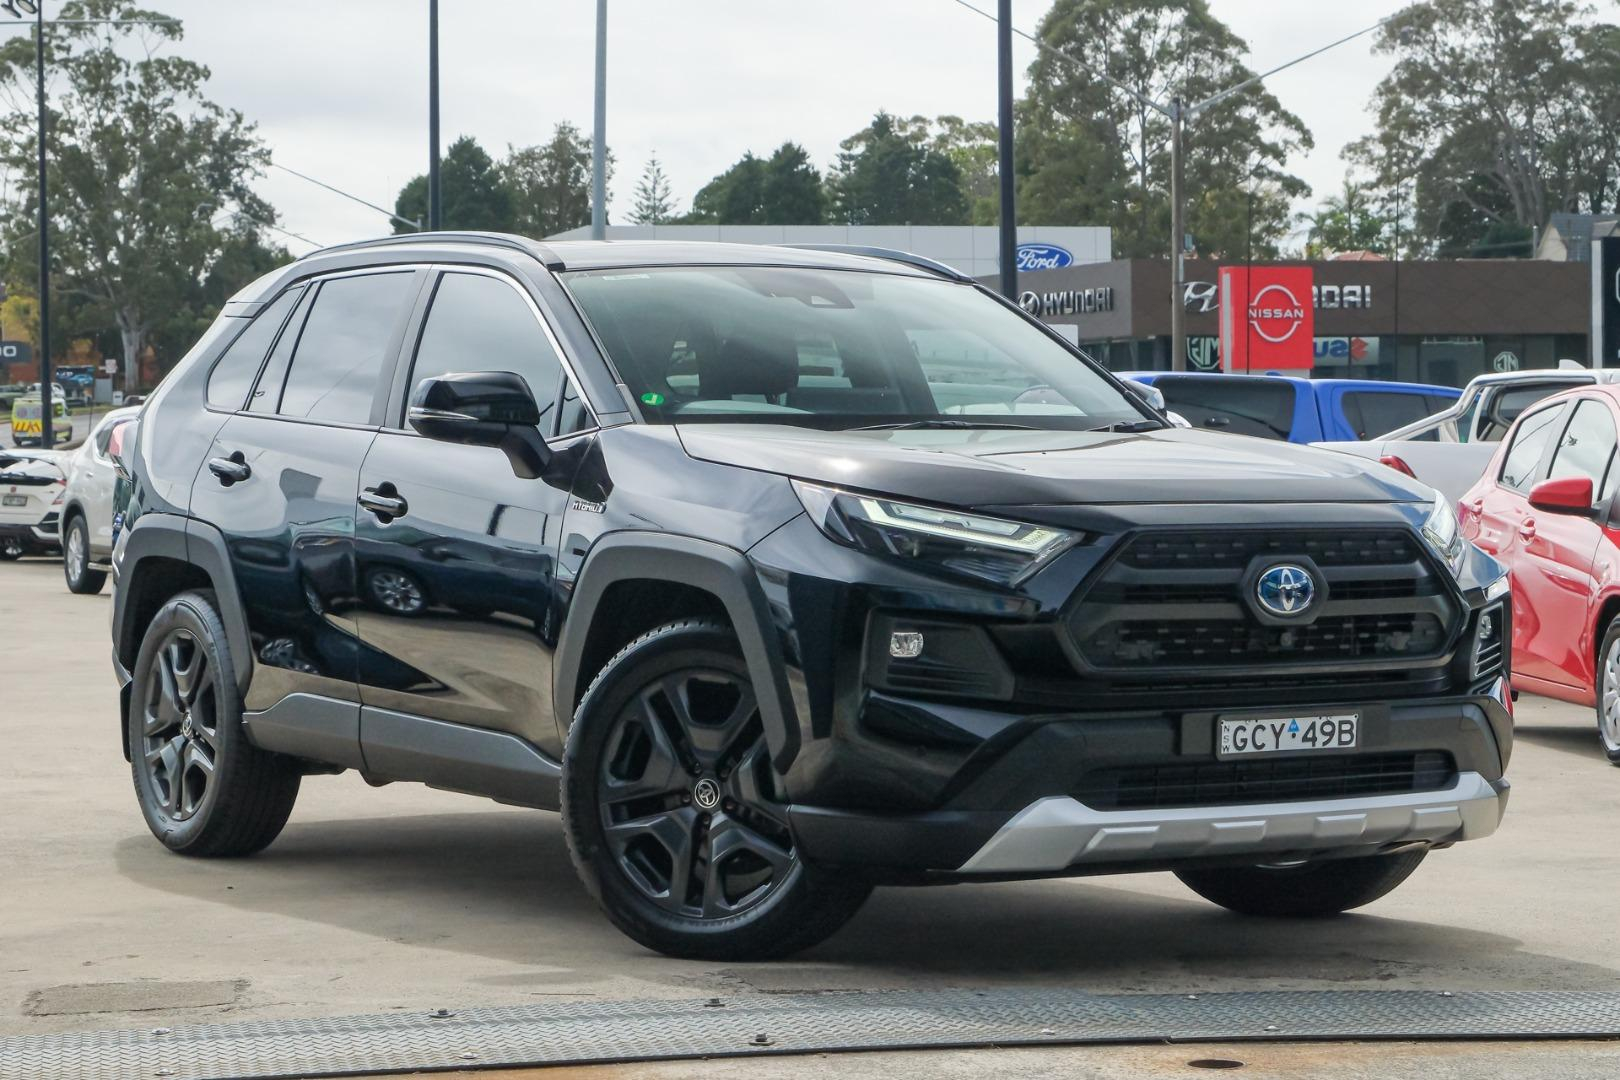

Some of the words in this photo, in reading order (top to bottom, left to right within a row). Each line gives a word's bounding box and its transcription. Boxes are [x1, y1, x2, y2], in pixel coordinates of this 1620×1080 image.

[1017, 248, 1060, 269] Ford
[1043, 286, 1111, 315] HYUNDAI
[1248, 308, 1304, 319] NISSAN
[1232, 722, 1286, 752] GCY
[1301, 719, 1355, 747] 49B
